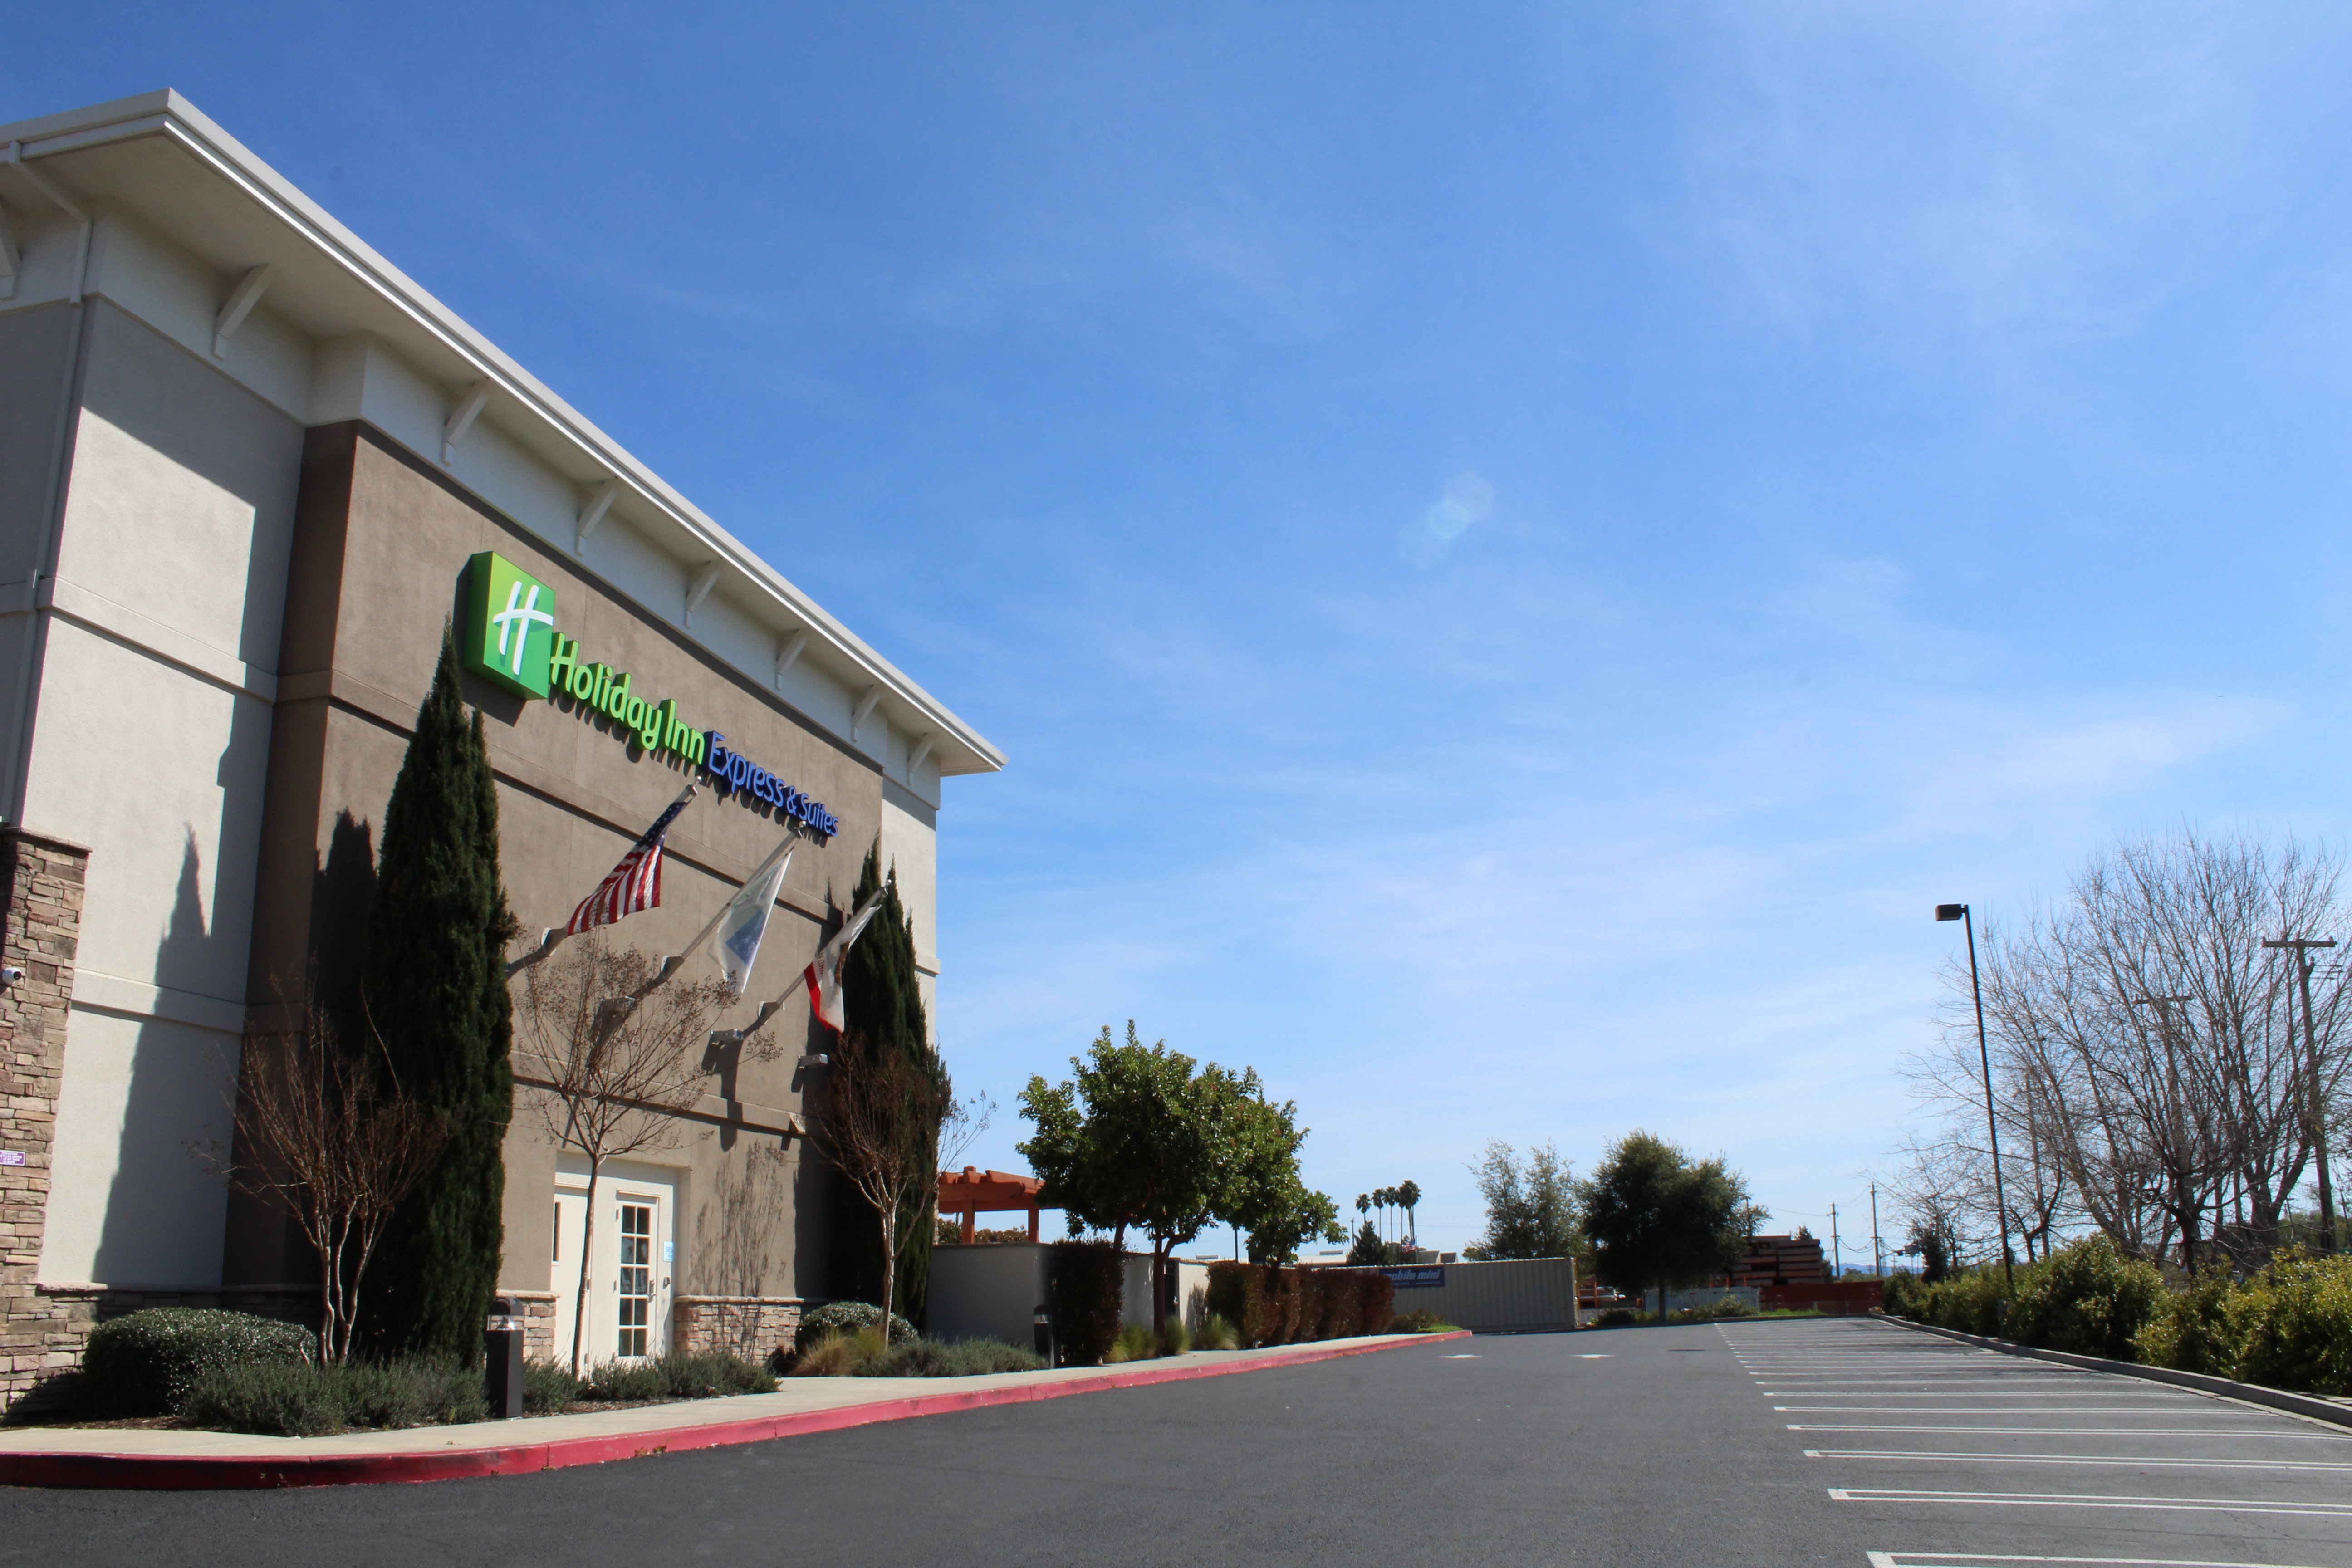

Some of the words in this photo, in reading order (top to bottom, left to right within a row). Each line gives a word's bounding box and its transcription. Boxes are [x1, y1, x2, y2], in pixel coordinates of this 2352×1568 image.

[550, 632, 662, 750] Holiday
[663, 699, 705, 765] Inn
[709, 730, 785, 807] Express
[786, 785, 796, 816] &
[799, 793, 839, 837] Suites
[1417, 1269, 1441, 1280] mini
